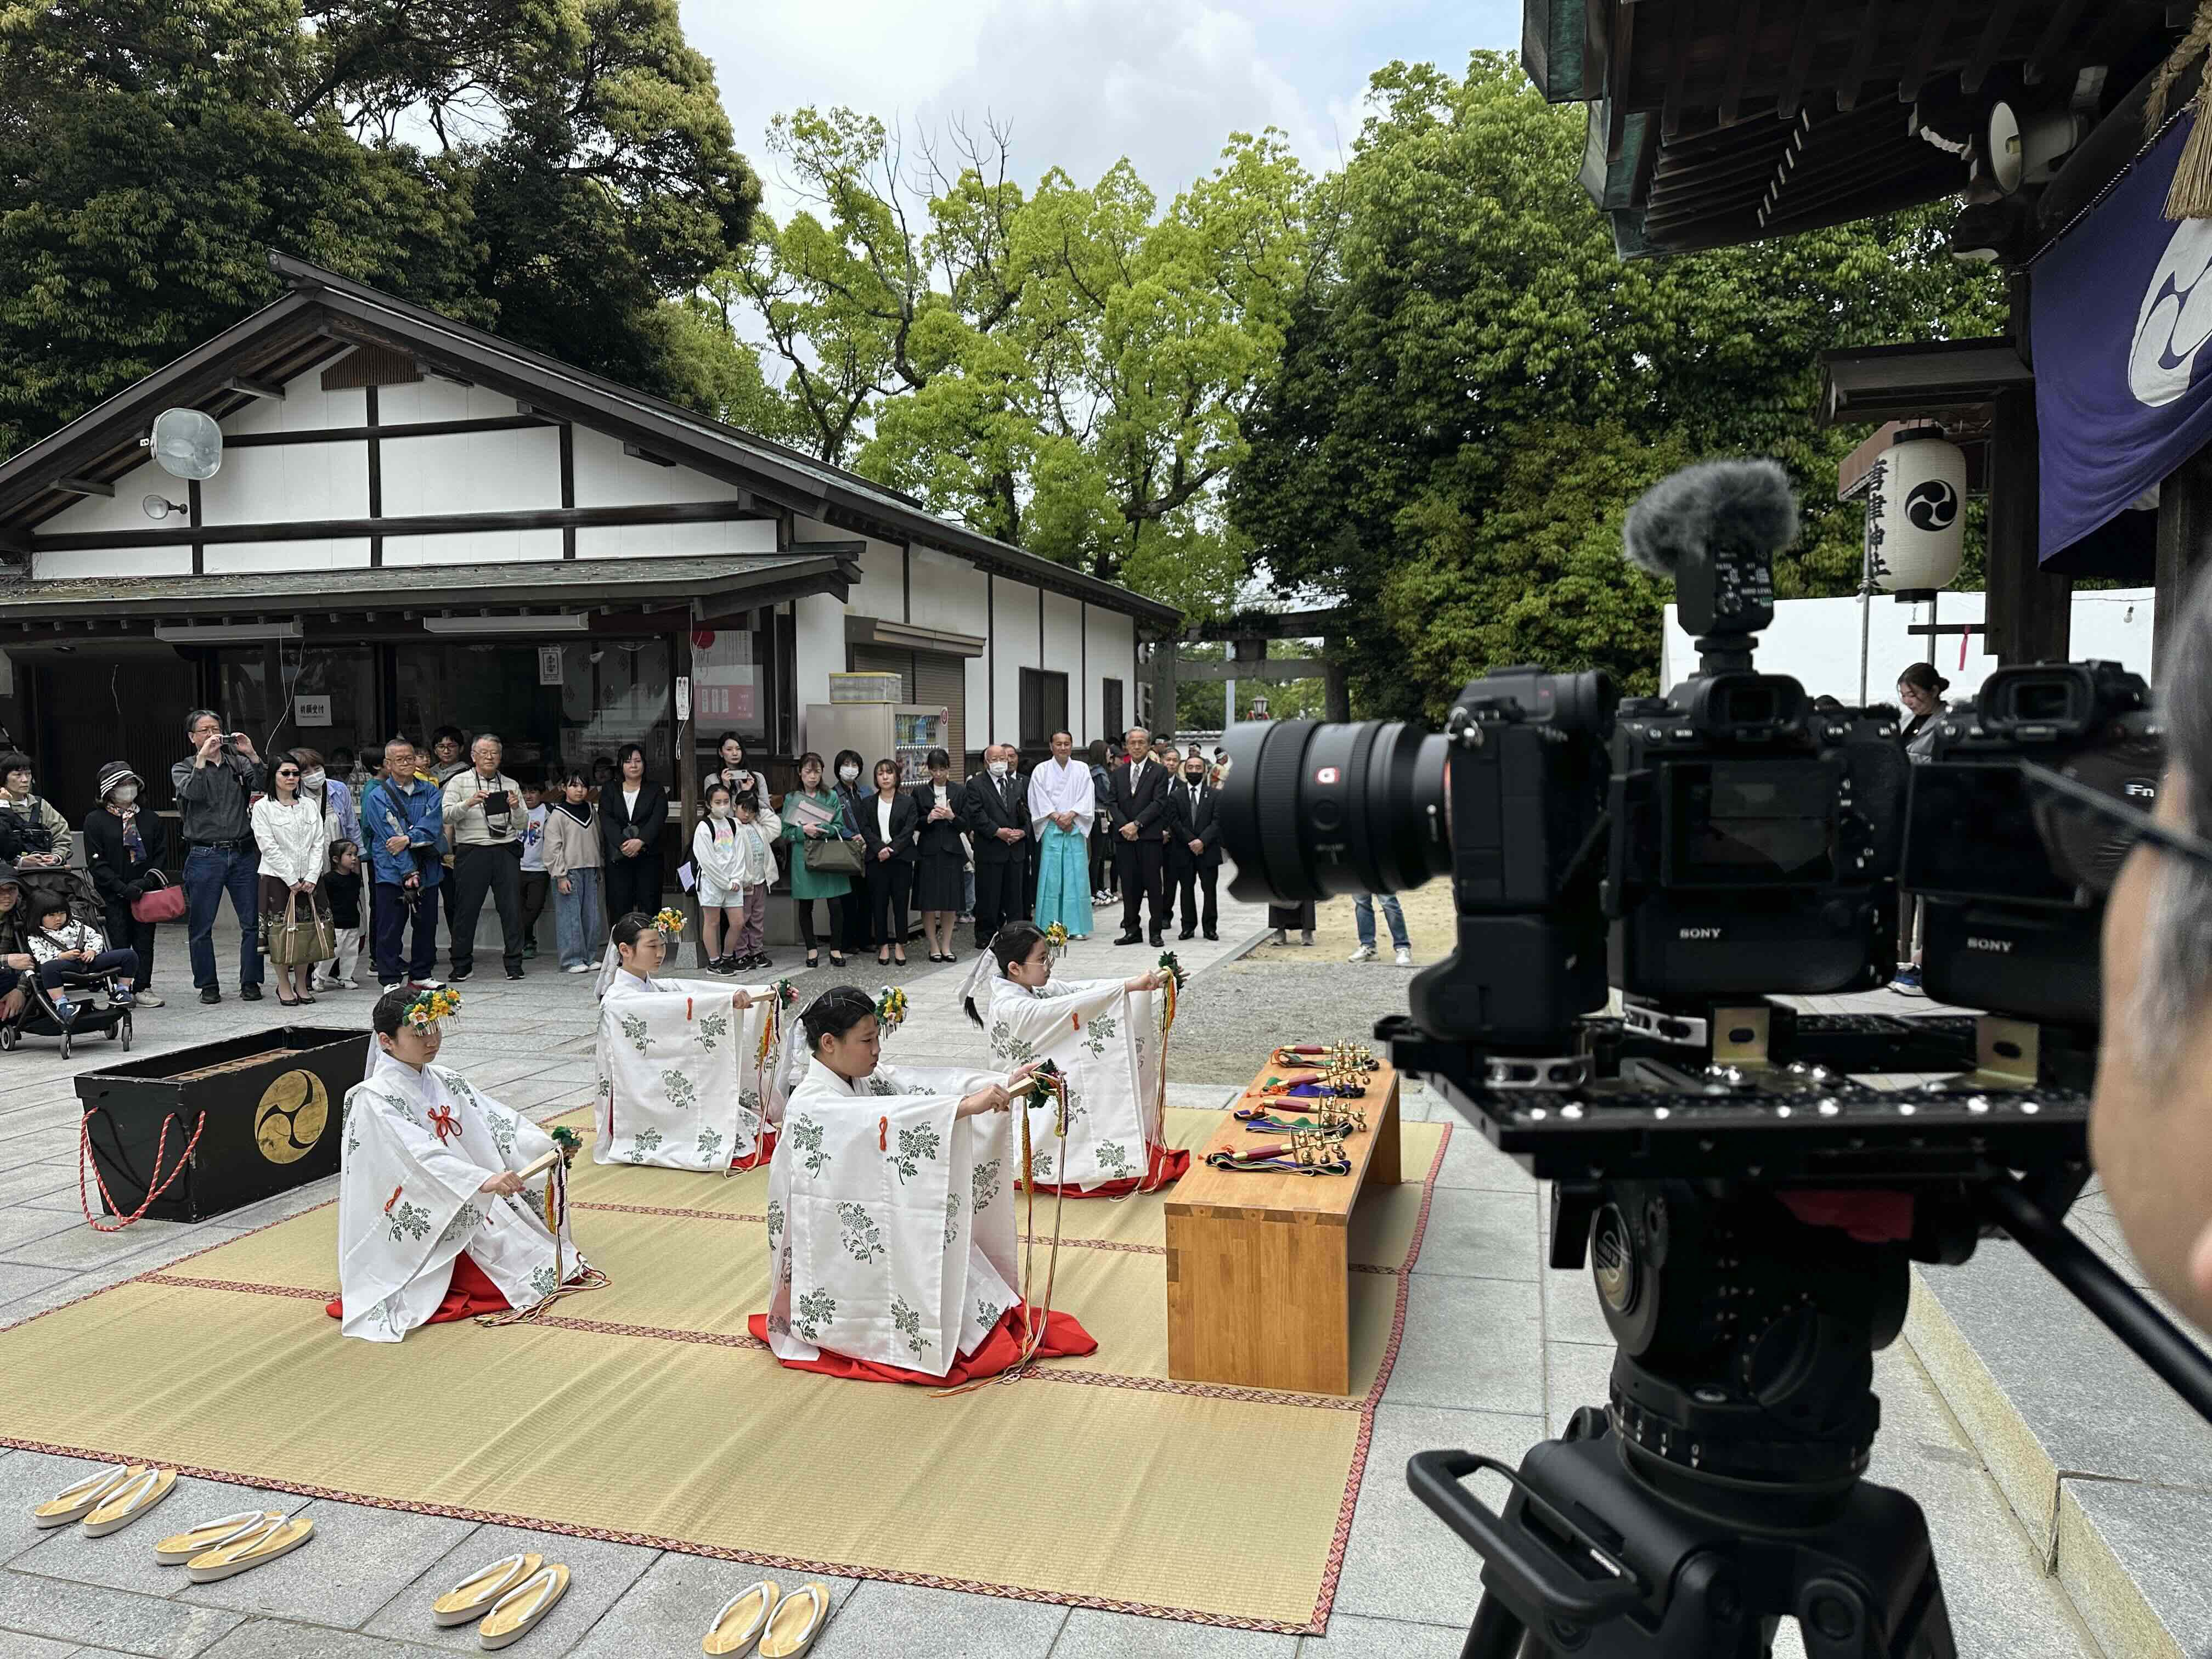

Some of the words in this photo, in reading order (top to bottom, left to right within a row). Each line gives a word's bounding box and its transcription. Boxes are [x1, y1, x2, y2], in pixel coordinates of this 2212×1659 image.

[2124, 783, 2155, 798] Fn
[1679, 928, 1722, 939] SONY
[1967, 937, 2013, 952] SONY
